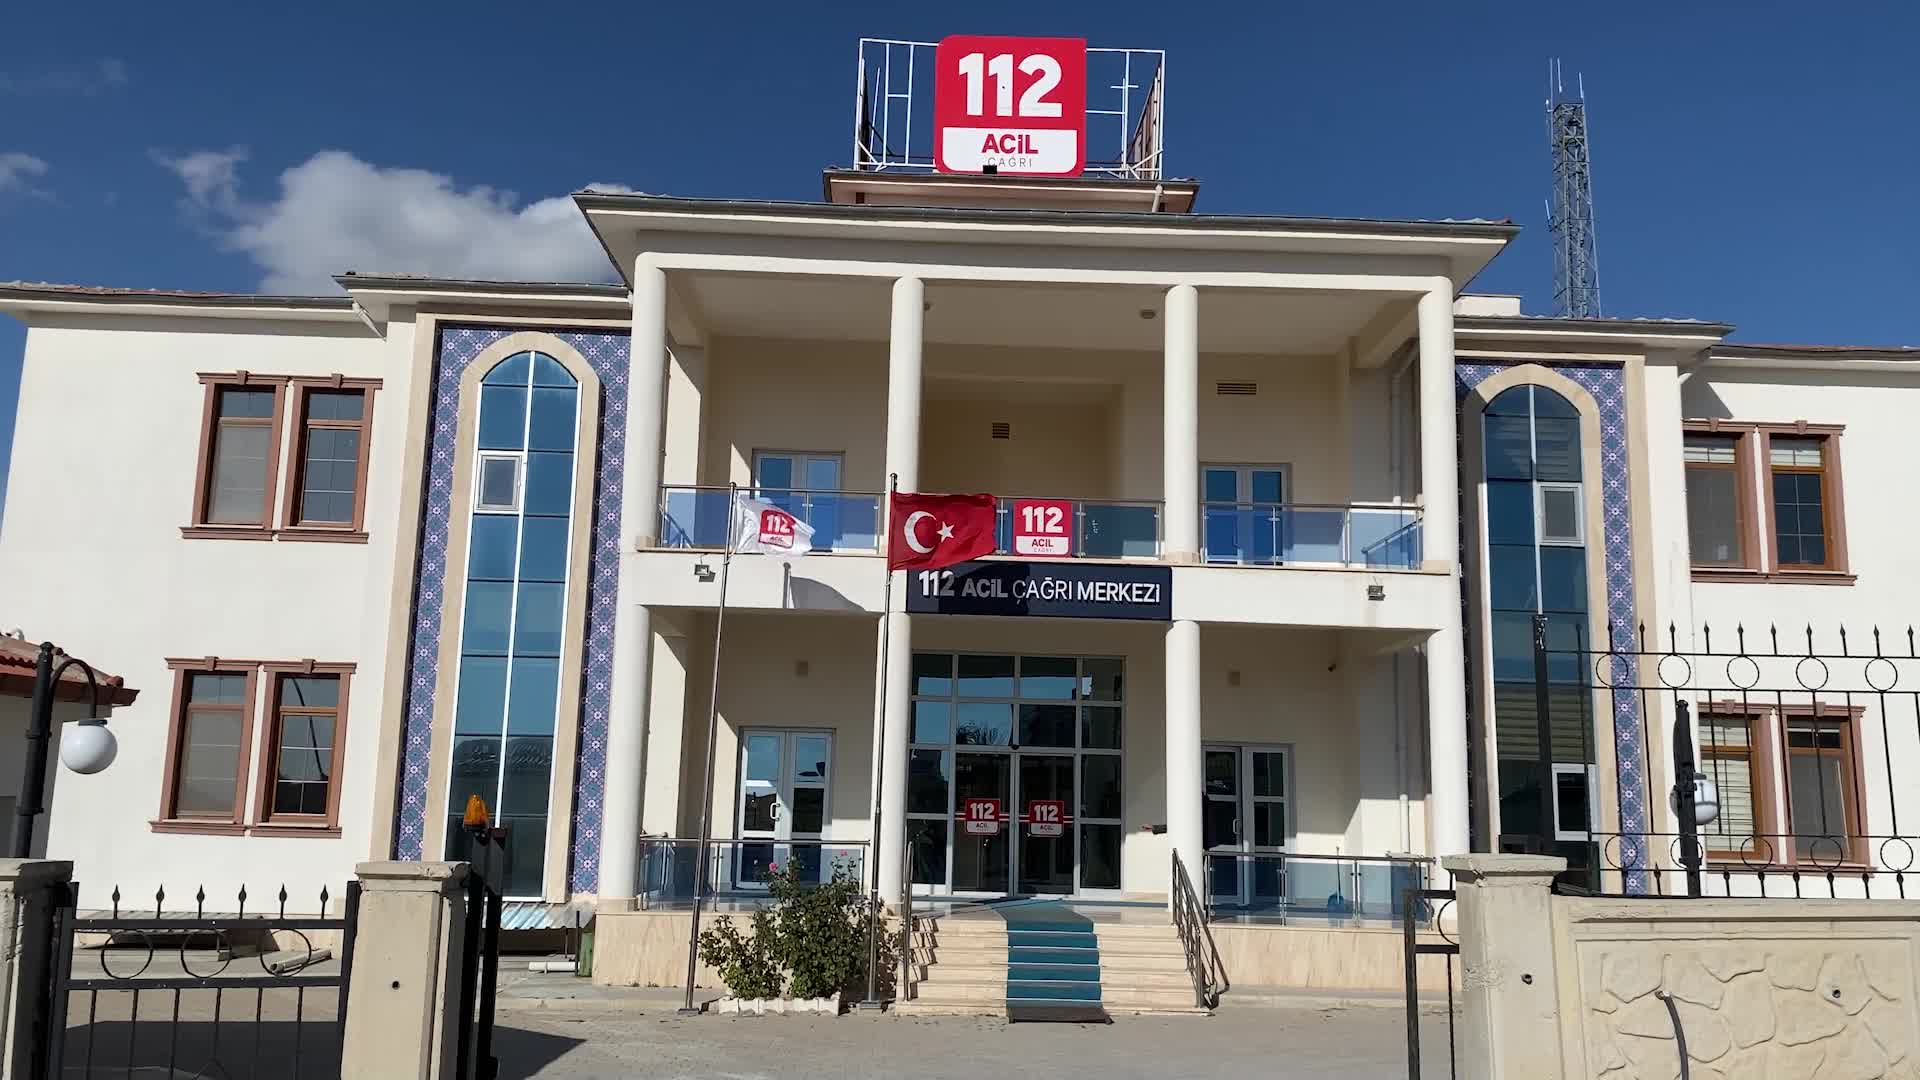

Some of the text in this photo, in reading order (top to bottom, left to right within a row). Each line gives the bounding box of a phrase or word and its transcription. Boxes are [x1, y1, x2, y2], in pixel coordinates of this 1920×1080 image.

[959, 53, 1062, 117] 112
[767, 515, 790, 533] 112
[1022, 506, 1063, 533] 112
[919, 570, 955, 596] 112
[1012, 577, 1073, 604] ÇAĞRI
[970, 803, 995, 819] 112
[1034, 805, 1059, 821] 112
